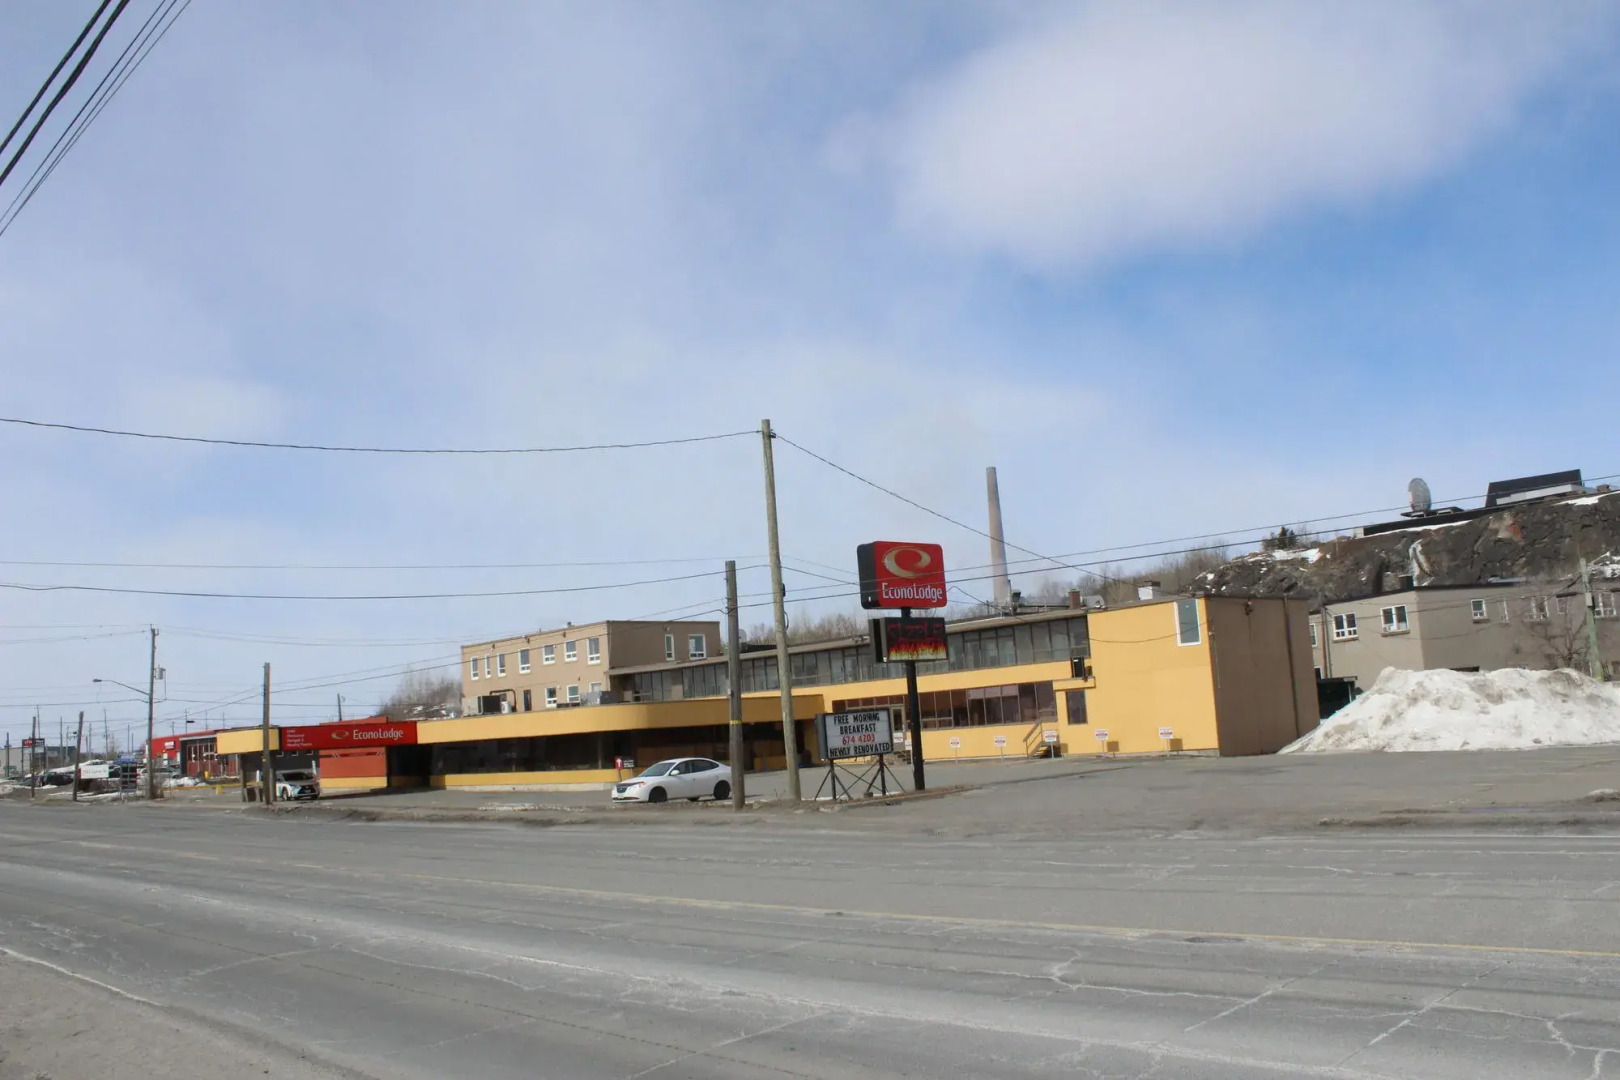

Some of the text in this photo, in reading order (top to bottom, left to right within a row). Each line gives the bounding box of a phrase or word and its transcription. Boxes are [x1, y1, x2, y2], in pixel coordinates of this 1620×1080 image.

[882, 582, 943, 602] EconoLodge
[834, 713, 880, 725] FREE MORNING
[353, 728, 404, 741] EconoLodge
[839, 723, 876, 735] BREAKFAST
[842, 733, 876, 745] 674 4203
[829, 745, 851, 757] NEWLY
[854, 742, 890, 754] RENOVATED
